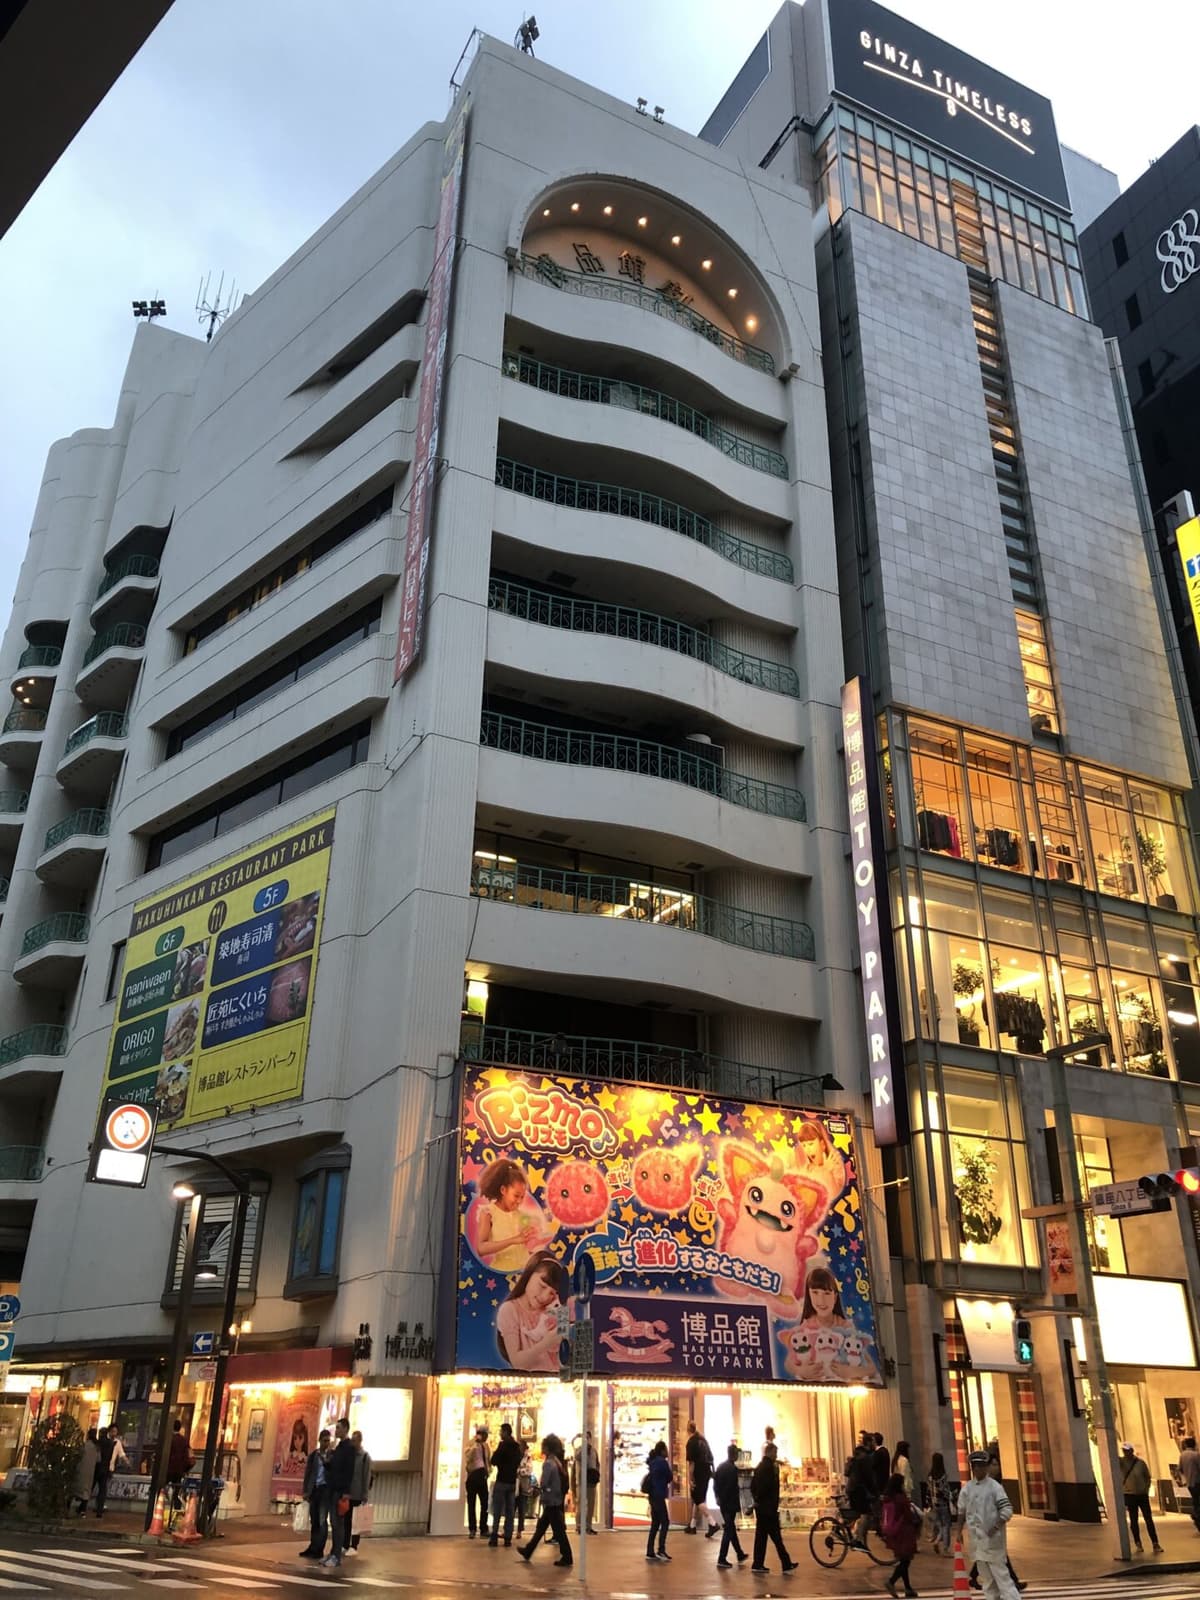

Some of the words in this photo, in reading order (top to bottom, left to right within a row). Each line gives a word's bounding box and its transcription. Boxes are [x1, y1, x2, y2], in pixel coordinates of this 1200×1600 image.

[860, 30, 923, 78] GINZA
[933, 70, 1032, 136] TIMELESS
[846, 730, 866, 816] 博品館
[136, 886, 205, 931] HAKUHINKAN
[210, 847, 286, 896] RESTAURANT
[292, 828, 325, 858] PARK
[854, 822, 874, 925] TOY
[262, 887, 279, 908] 5F
[162, 933, 176, 951] 6F
[218, 922, 274, 960] 築地寿司清
[125, 969, 172, 998] naniwaen
[122, 1026, 155, 1052] ORIGO
[865, 951, 890, 1108] PARK
[198, 1050, 296, 1093] 博品館レストランパーク
[525, 1125, 567, 1146] リズモ
[681, 1311, 761, 1347] 博品館
[682, 1345, 763, 1356] HAKUHINKAN
[682, 1354, 716, 1367] TOY
[723, 1355, 764, 1369] PARK
